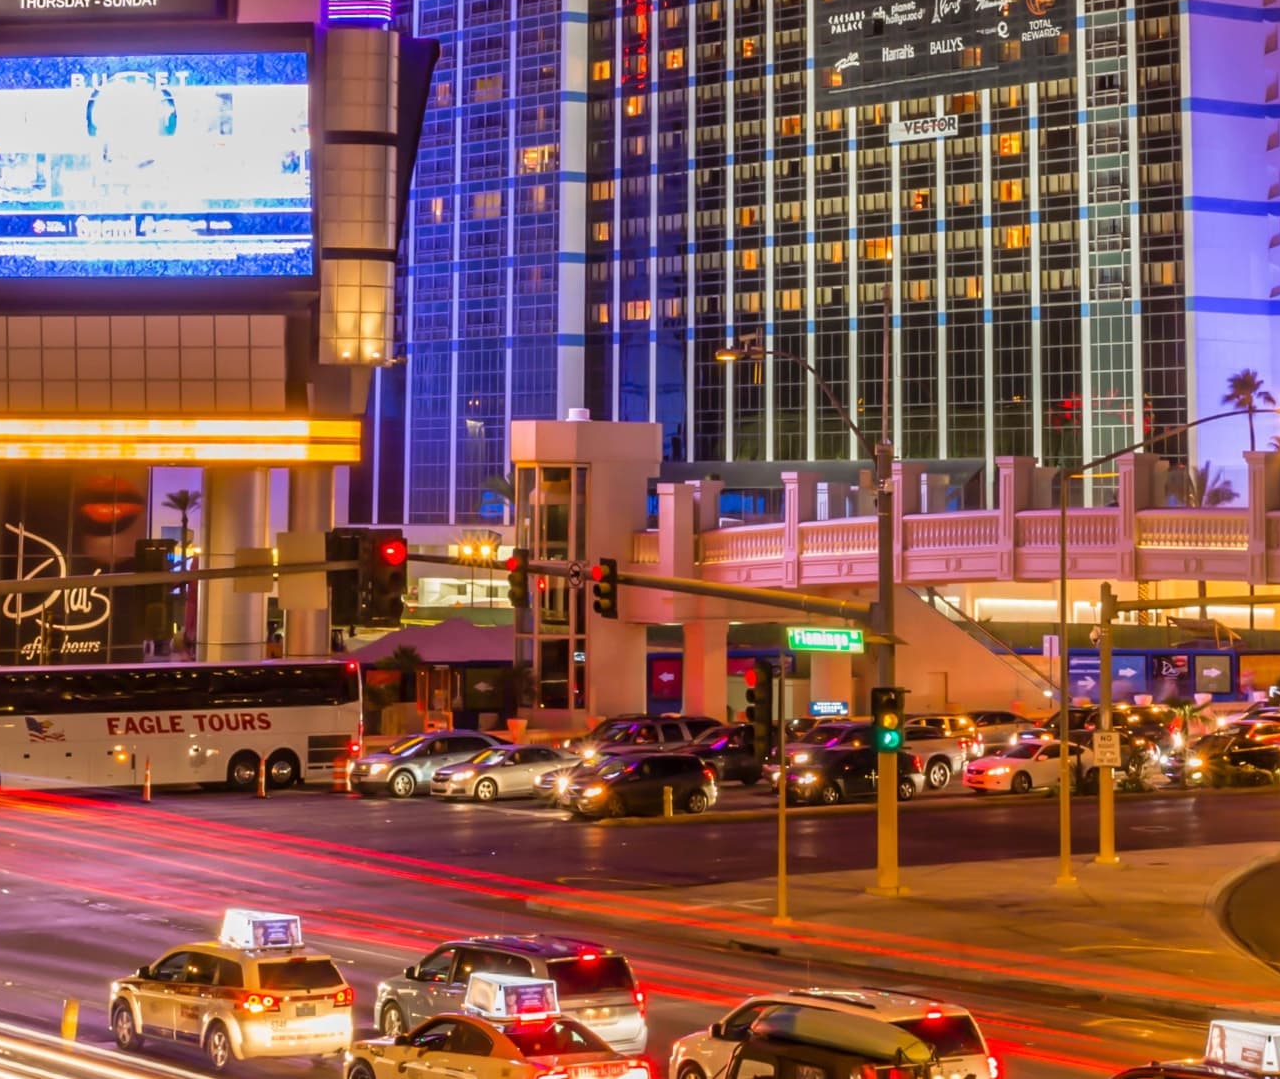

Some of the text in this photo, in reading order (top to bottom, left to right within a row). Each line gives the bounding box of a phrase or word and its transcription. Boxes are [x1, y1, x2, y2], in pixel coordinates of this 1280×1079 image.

[828, 10, 866, 25] CAESARS
[1029, 19, 1053, 30] TOTAL
[831, 21, 863, 35] PALACE
[904, 117, 957, 135] VECTOR
[60, 635, 101, 653] hours
[106, 713, 271, 735] EAGLE TOURS
